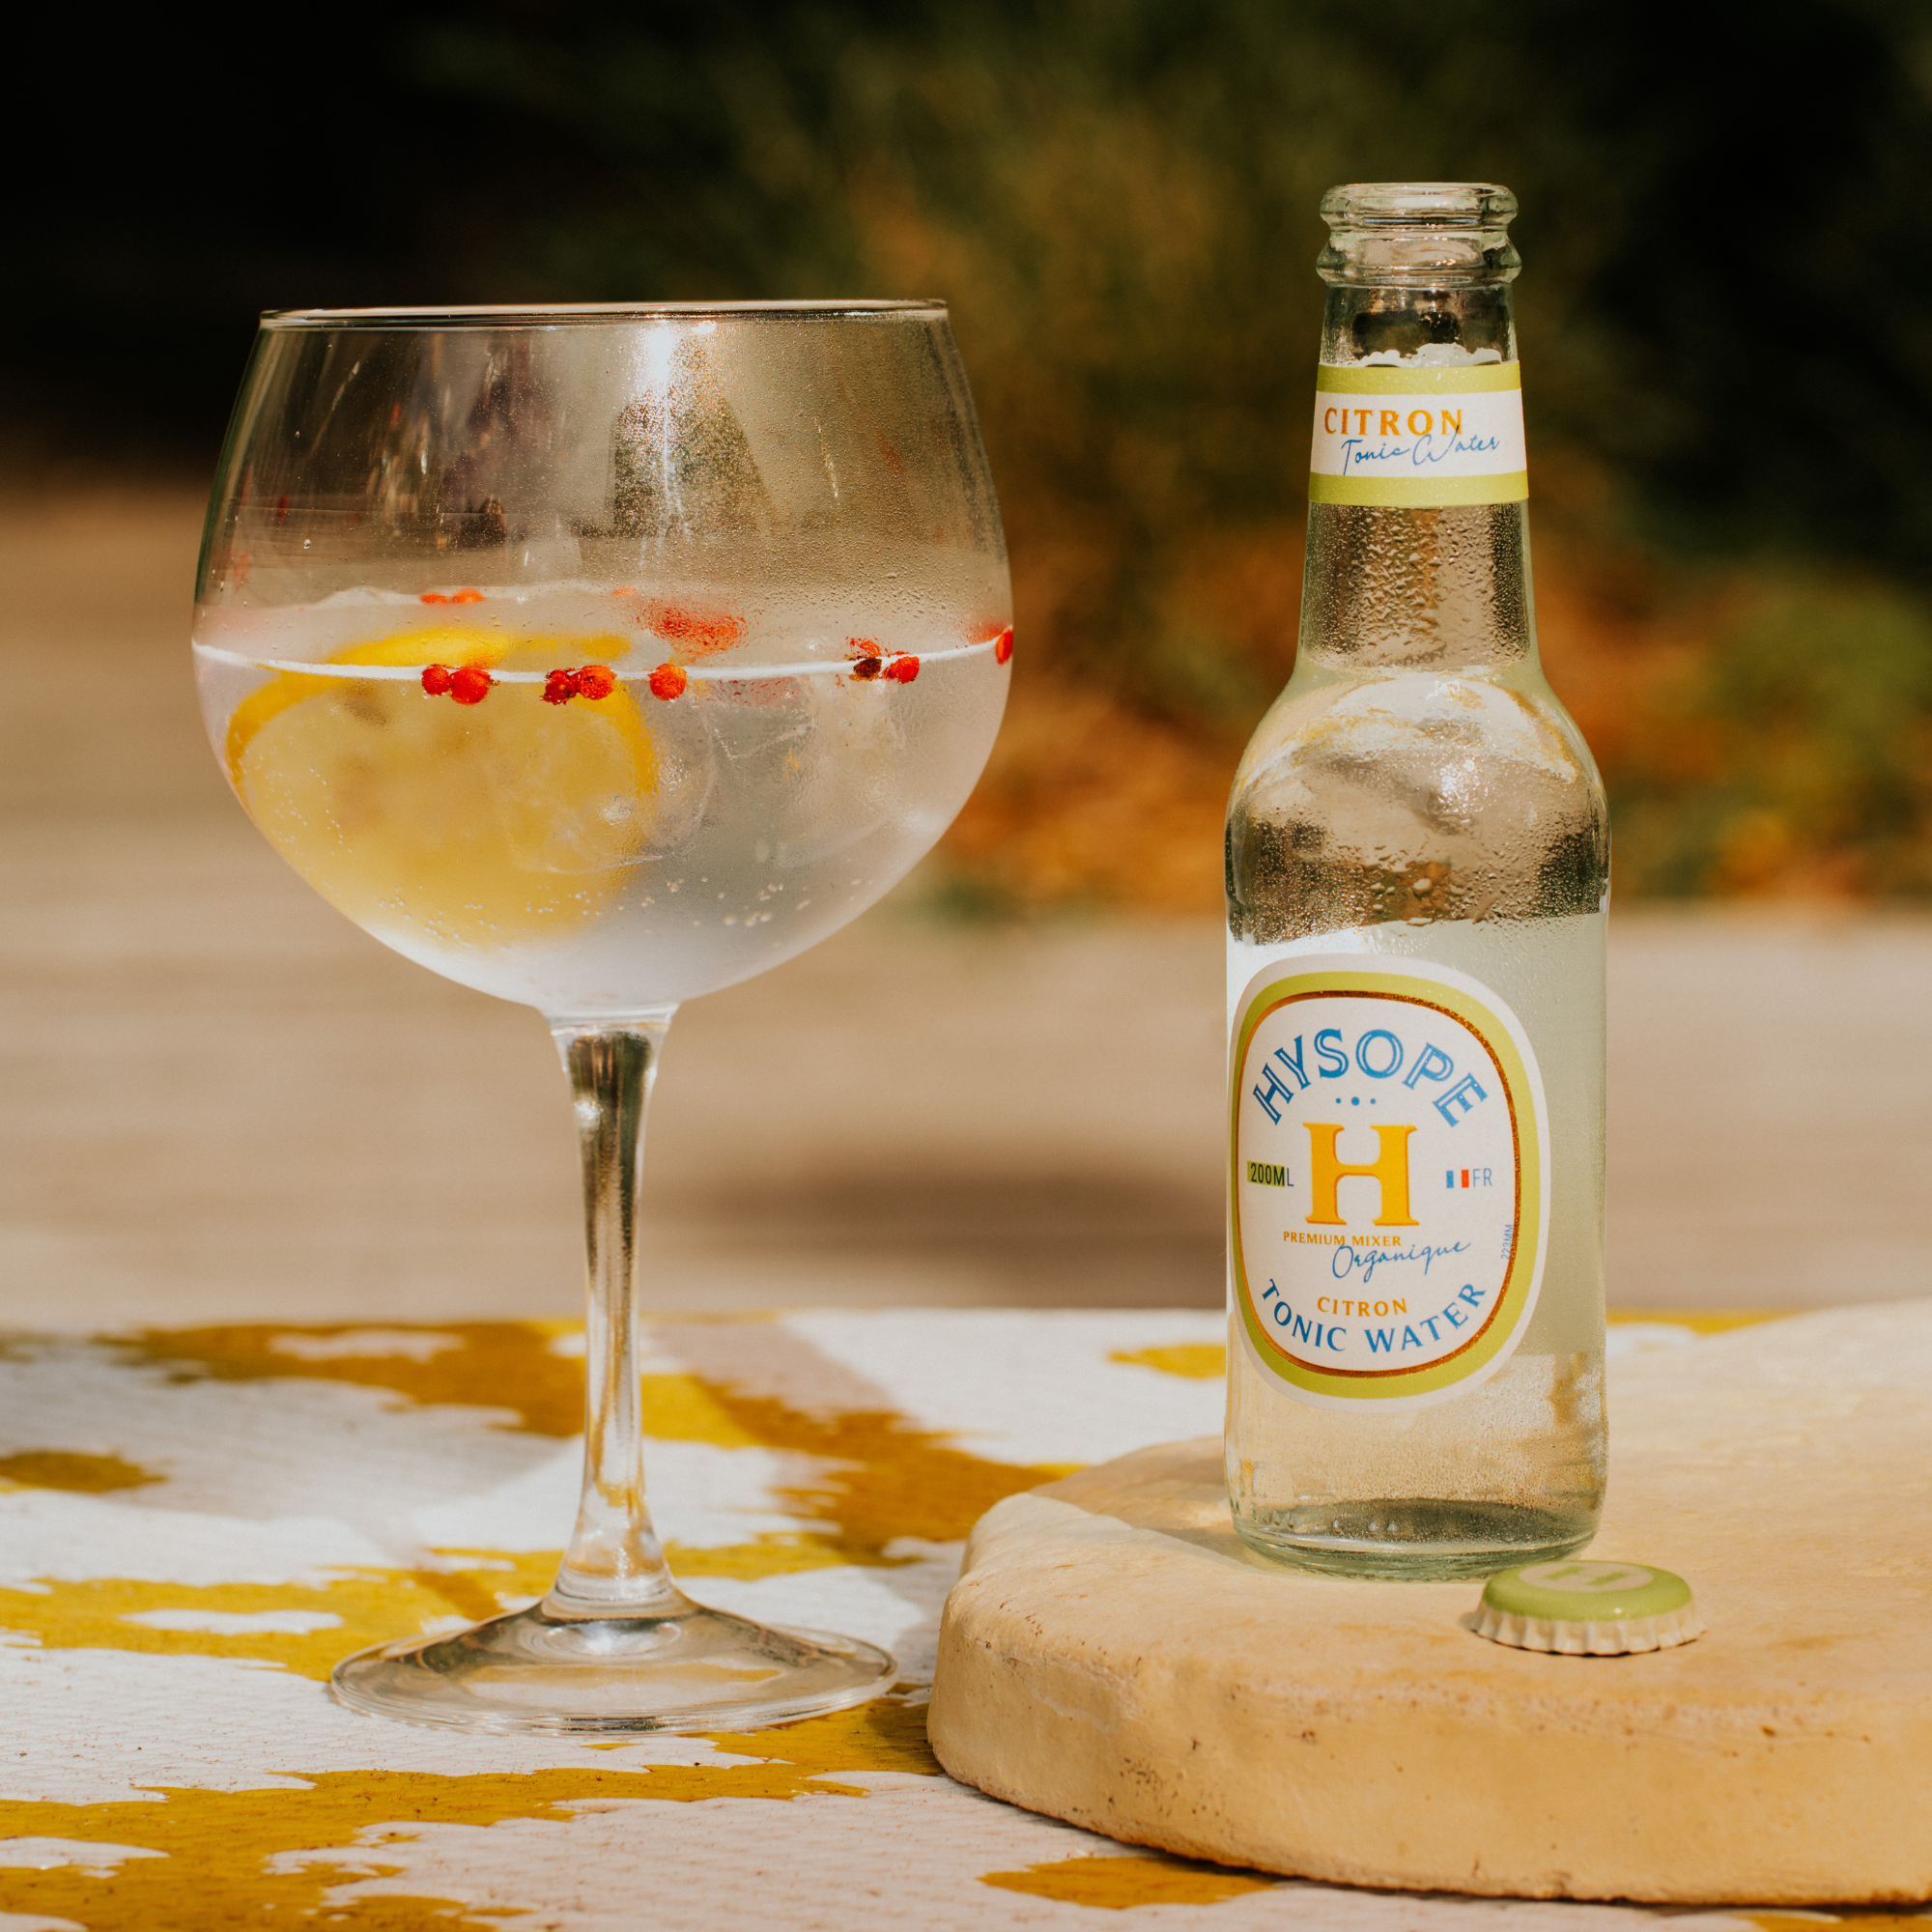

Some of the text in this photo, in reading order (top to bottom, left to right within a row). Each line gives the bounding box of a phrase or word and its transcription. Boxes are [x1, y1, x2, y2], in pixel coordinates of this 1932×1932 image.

[1324, 407, 1463, 436] CITRON
[1341, 424, 1500, 476] Tonic Water
[1252, 1028, 1489, 1128] HYSOPE
[1250, 1162, 1294, 1188] 200ML
[1302, 1122, 1420, 1227] H
[1472, 1167, 1493, 1188] FR
[1283, 1231, 1402, 1247] PREMIUM MIXER
[1332, 1241, 1471, 1283] Organique
[1262, 1278, 1488, 1353] TONIC WATER
[1317, 1296, 1408, 1318] CITRON
